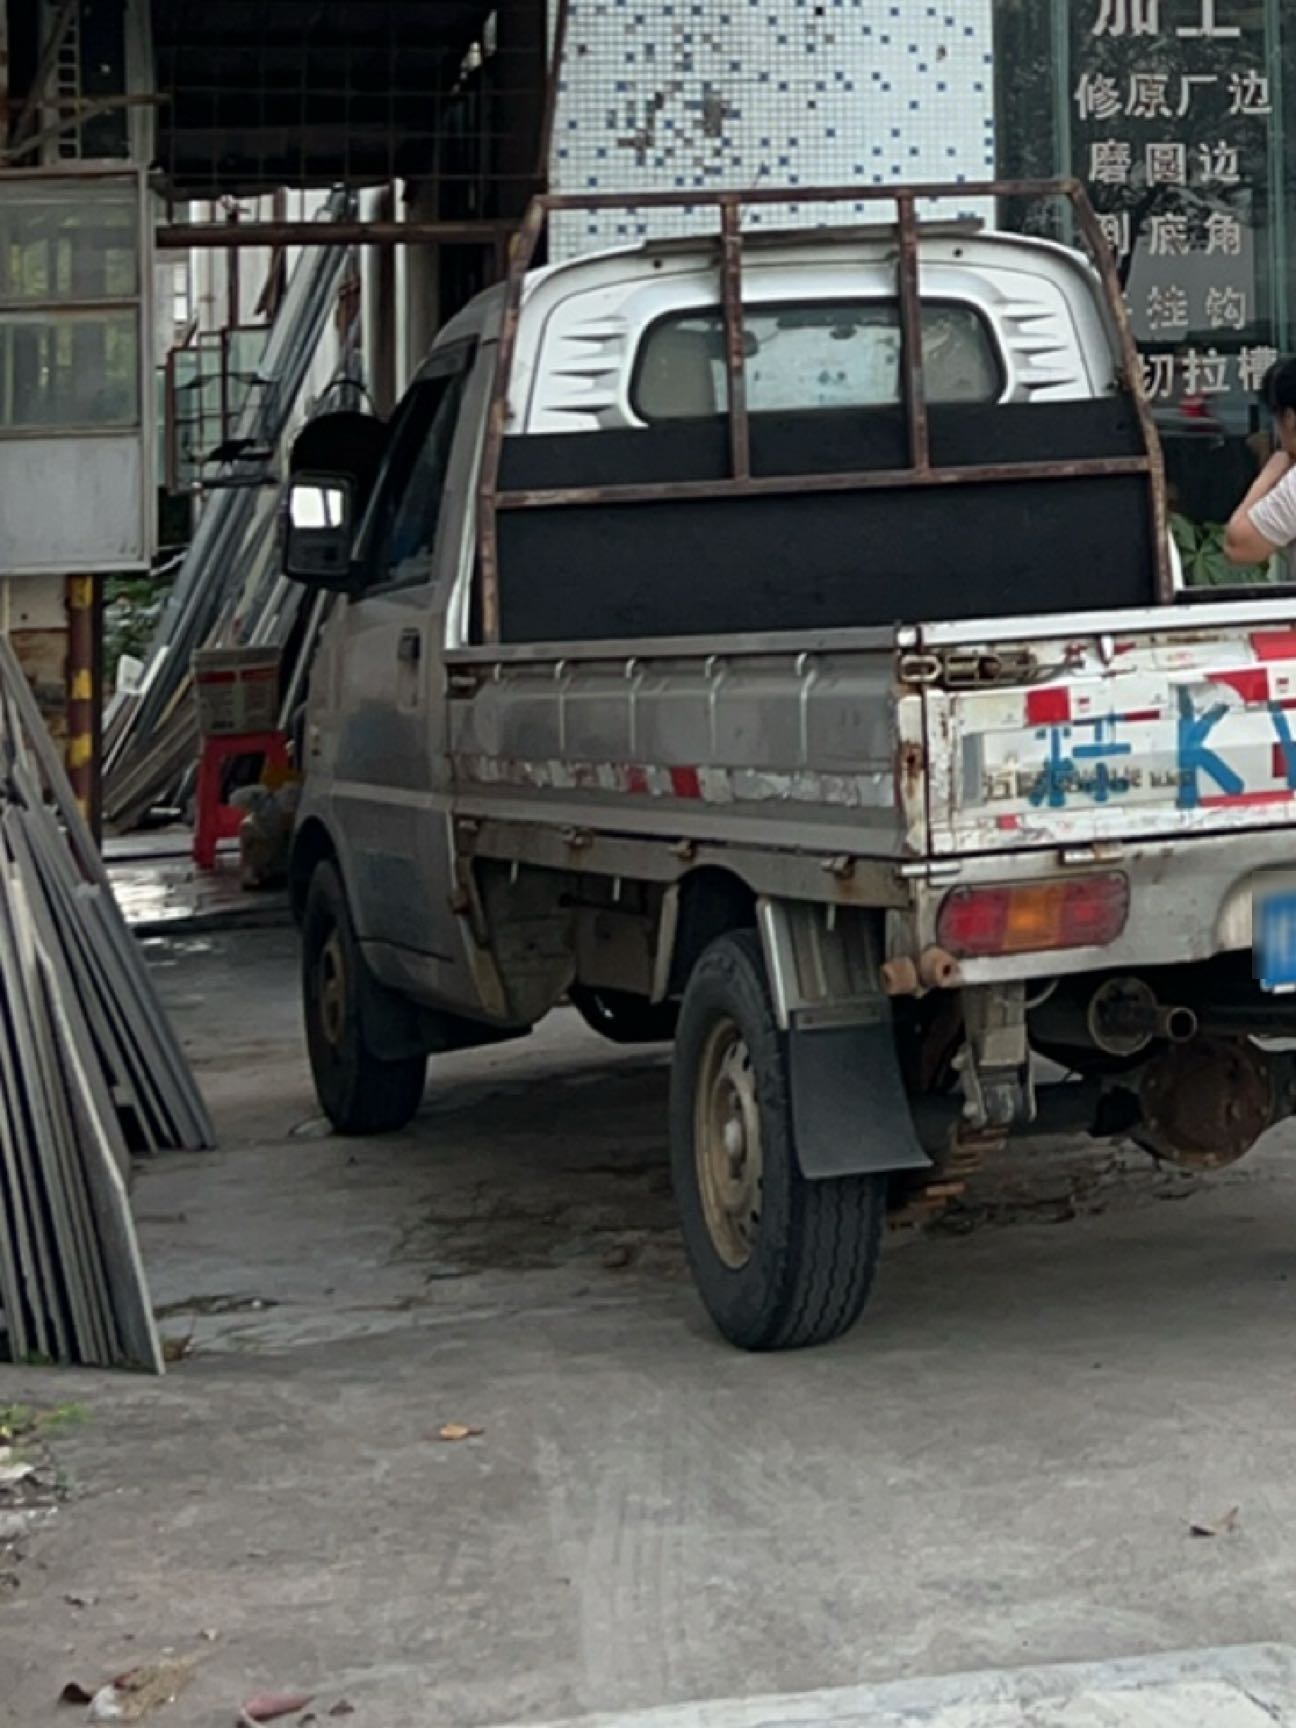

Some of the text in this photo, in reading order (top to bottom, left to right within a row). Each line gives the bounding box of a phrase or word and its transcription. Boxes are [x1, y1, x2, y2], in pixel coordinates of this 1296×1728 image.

[1073, 70, 1273, 121] 修原厂边
[1122, 284, 1247, 330] 挂钩
